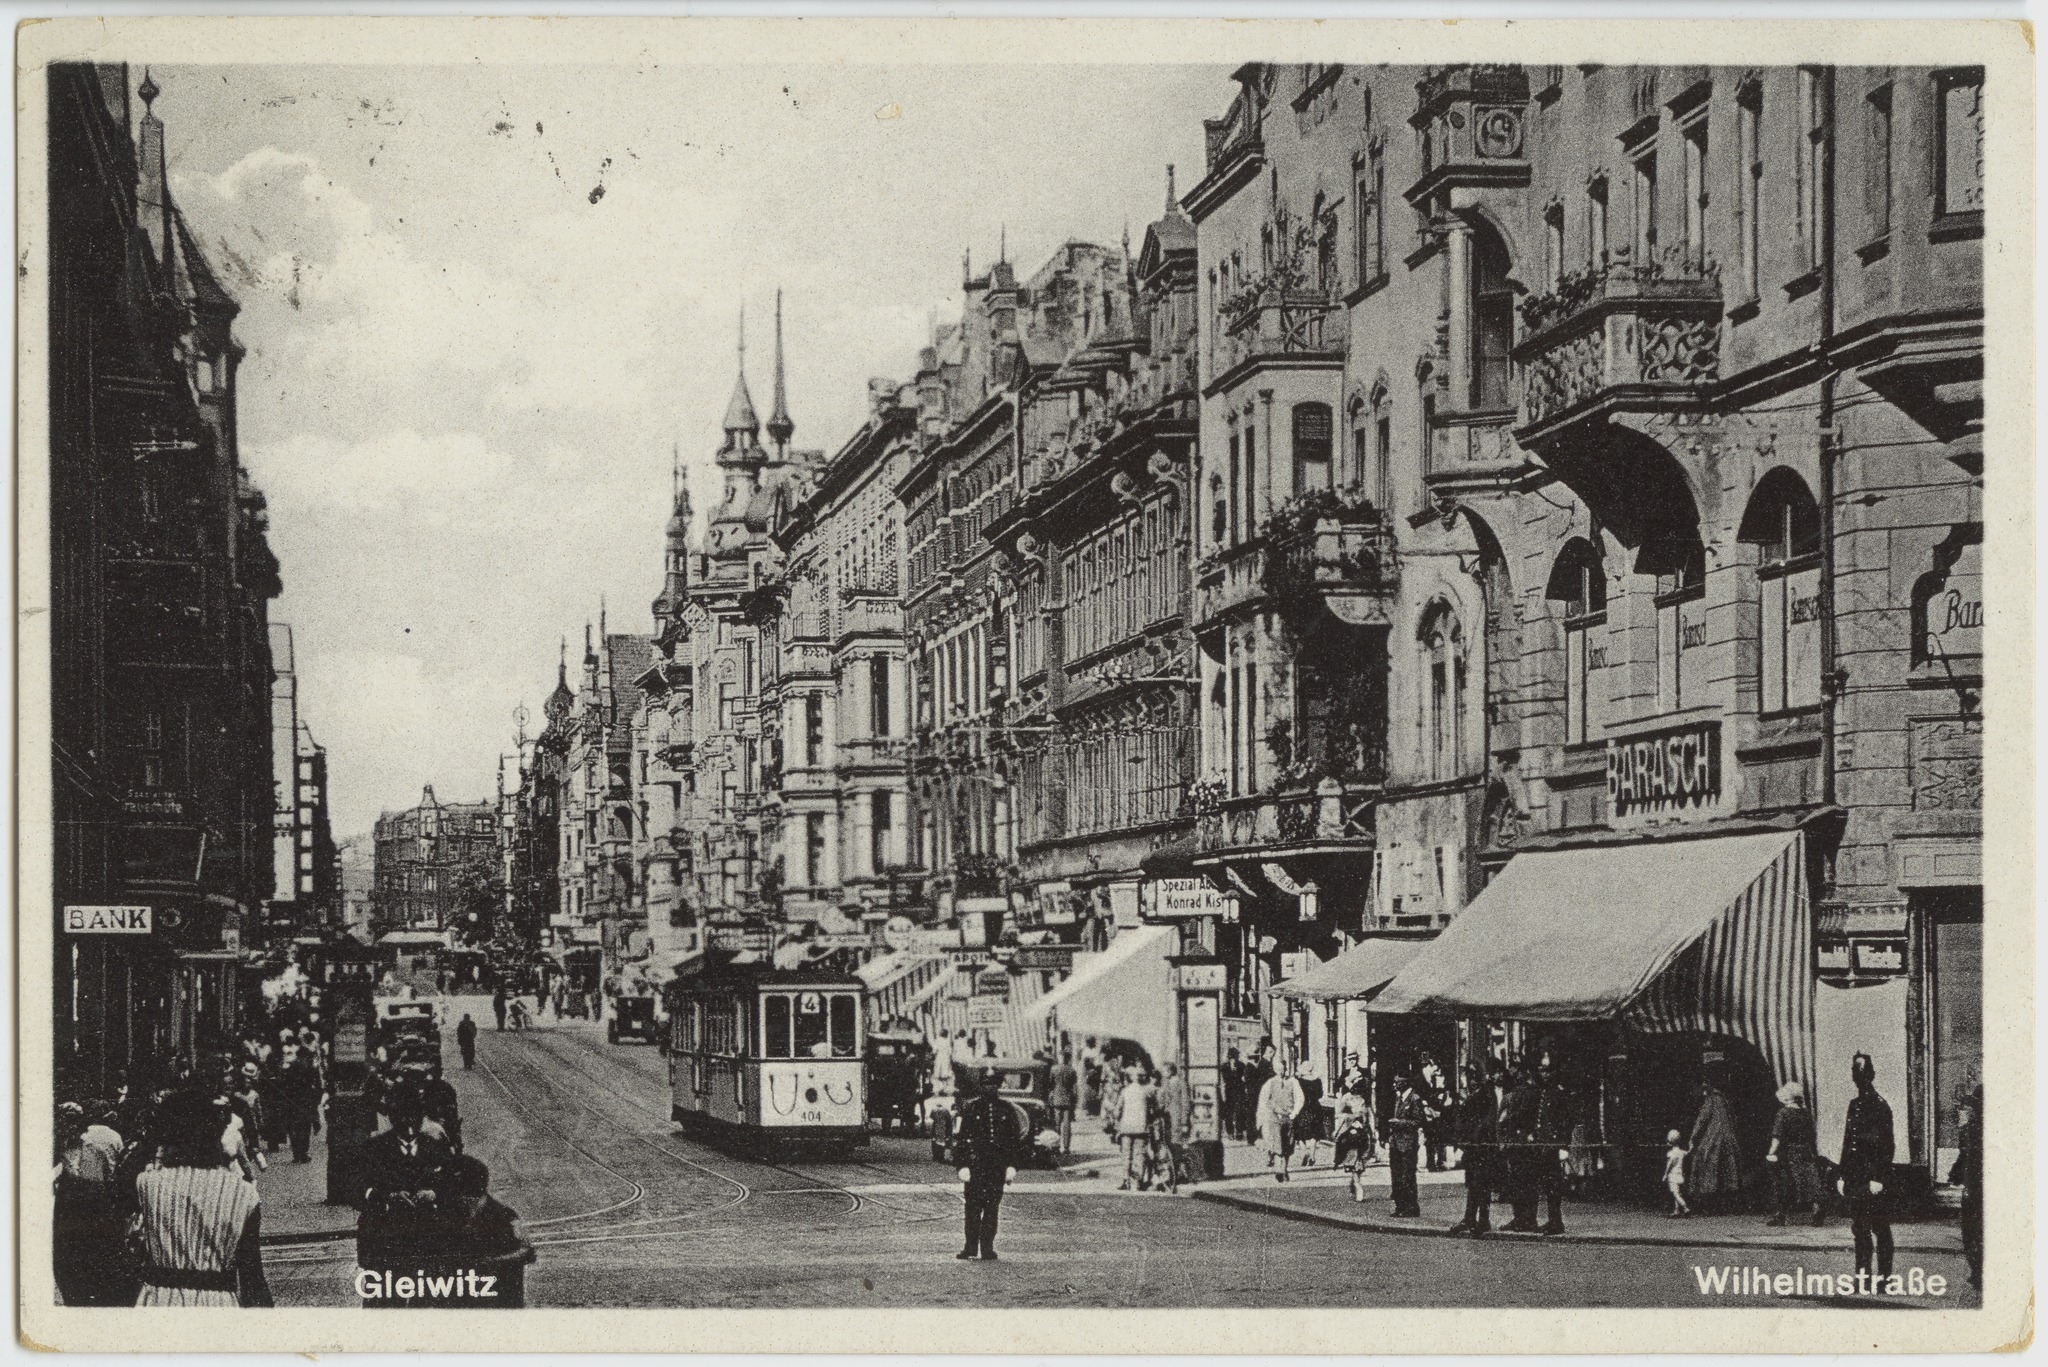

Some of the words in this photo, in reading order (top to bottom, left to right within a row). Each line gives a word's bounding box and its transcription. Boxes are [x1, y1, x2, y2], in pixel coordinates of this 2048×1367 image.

[1941, 589, 1983, 634] Bar
[1606, 730, 1709, 802] BARASCH
[1162, 878, 1196, 892] Spezial
[1166, 893, 1202, 909] Konrad
[69, 908, 147, 930] BANK
[804, 996, 817, 1012] 4
